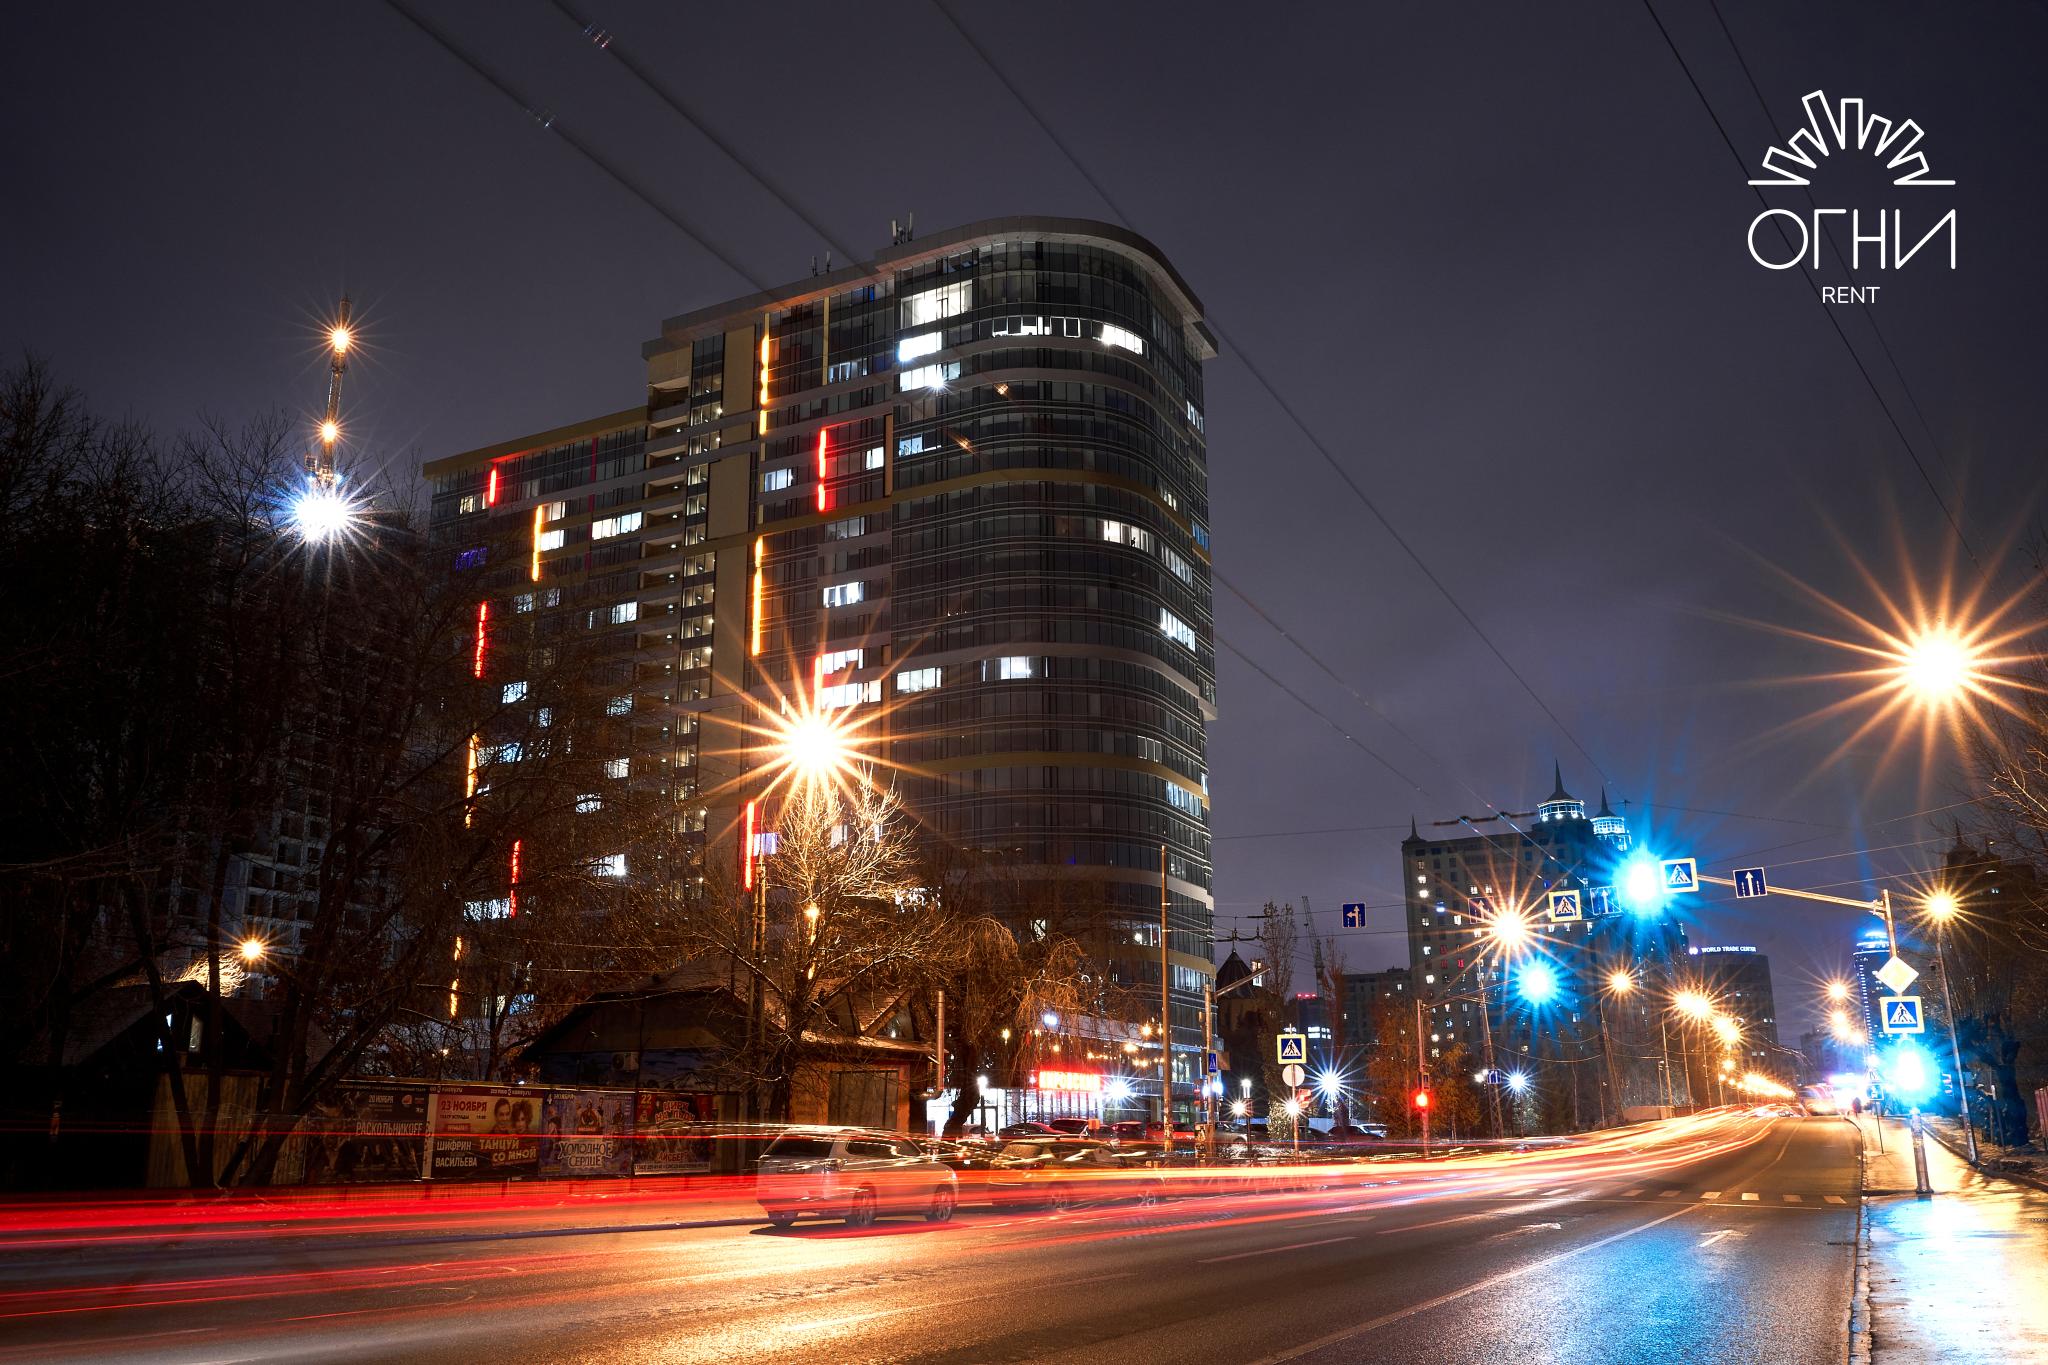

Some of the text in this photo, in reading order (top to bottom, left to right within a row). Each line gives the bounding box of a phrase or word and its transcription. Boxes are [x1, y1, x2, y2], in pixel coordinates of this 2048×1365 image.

[641, 1094, 652, 1104] 22
[441, 1101, 487, 1111] 23 НОЯБРЯ
[437, 1141, 471, 1151] ШИФРИН
[480, 1137, 520, 1150] ТАНЦУЙ
[492, 1147, 537, 1162] СО МНОЙ
[557, 1141, 613, 1160] ХОЛОДНОЕ
[435, 1157, 478, 1168] ВАСИЛЬЕВА
